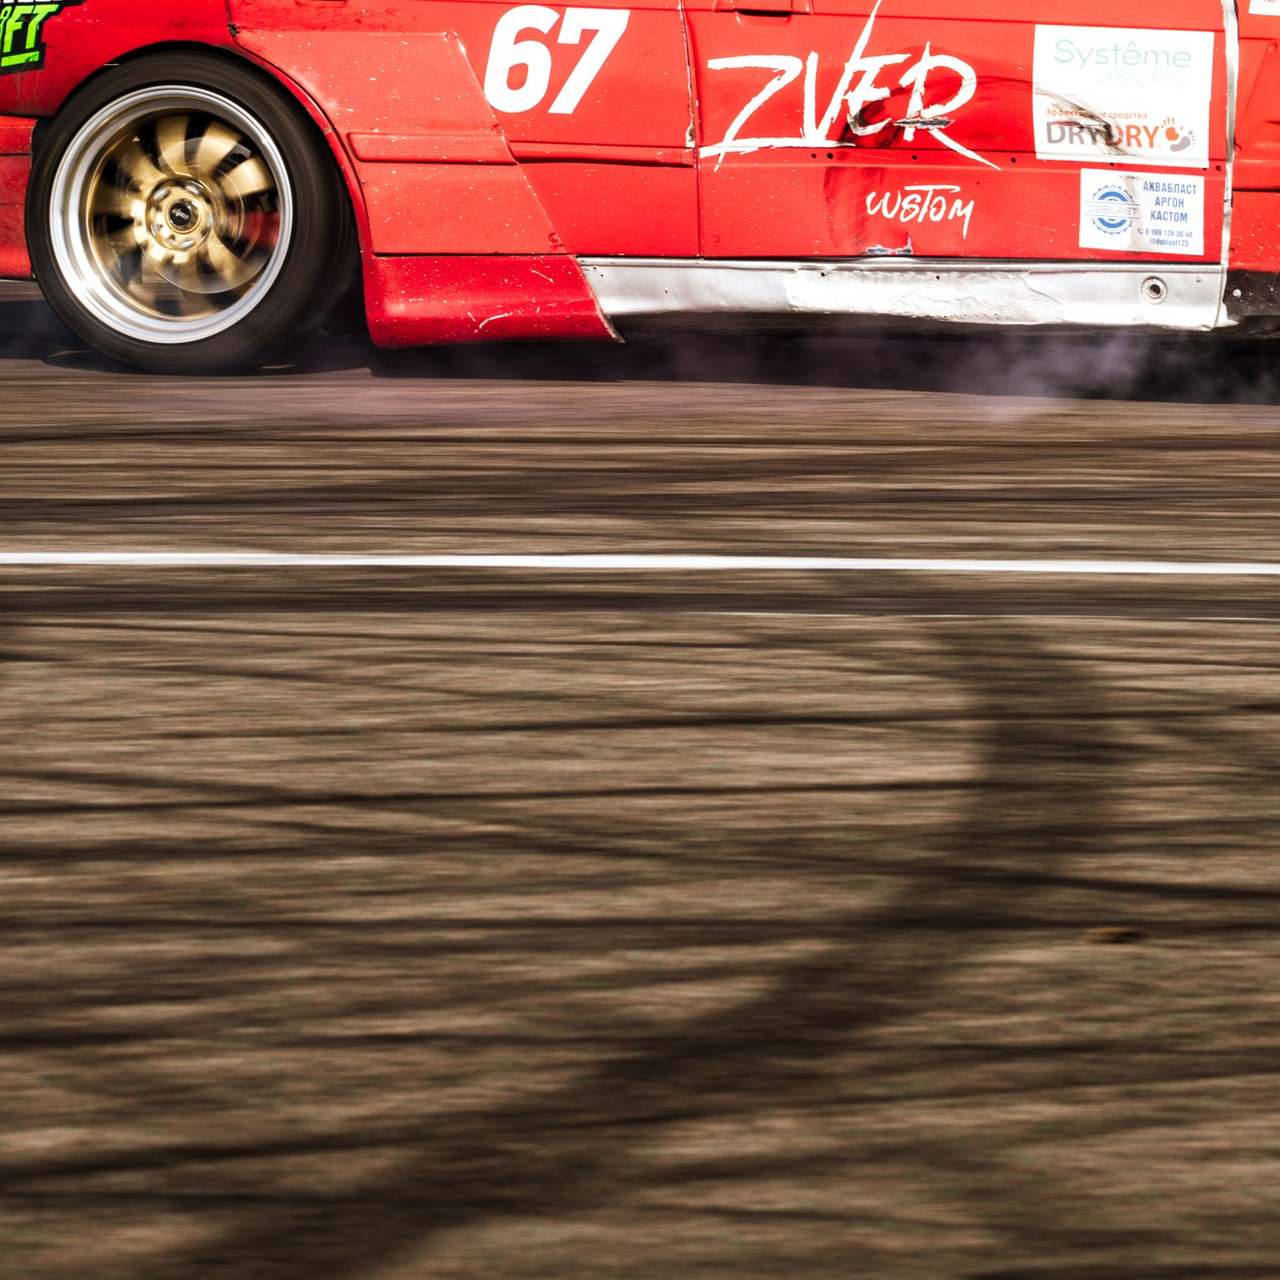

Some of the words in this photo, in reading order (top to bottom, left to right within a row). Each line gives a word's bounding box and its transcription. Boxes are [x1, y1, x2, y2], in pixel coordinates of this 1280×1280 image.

[484, 5, 631, 114] 67
[1097, 70, 1191, 89] electric
[1143, 181, 1197, 195] АКВАБЛАСТ
[1155, 196, 1184, 208] АРГОН
[1150, 210, 1188, 222] КАСТОМ
